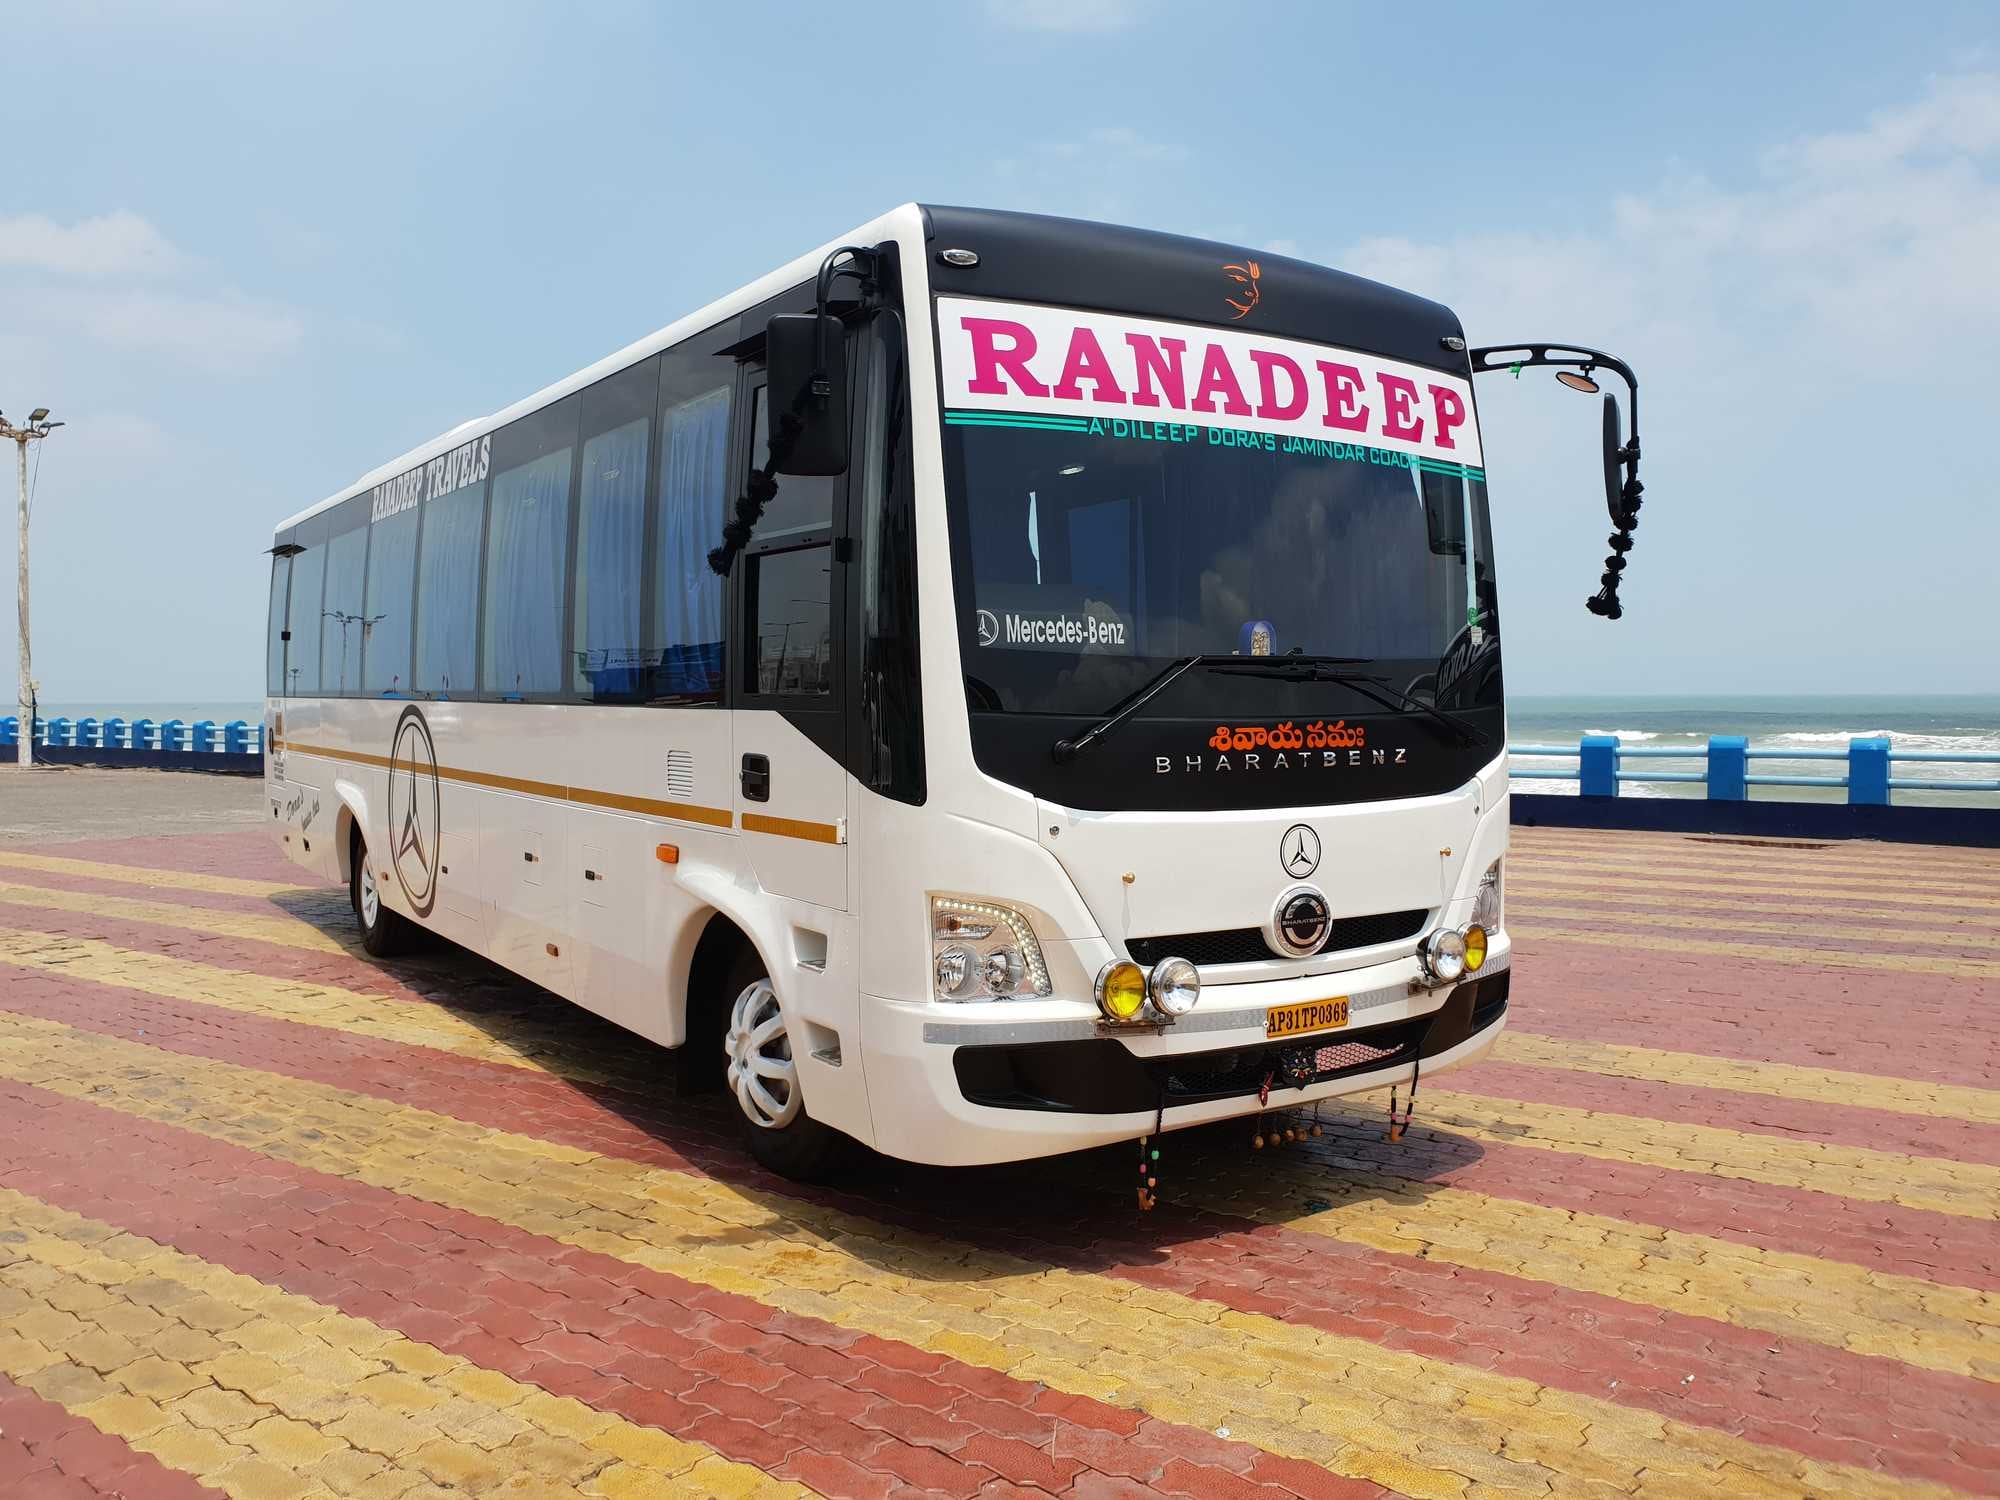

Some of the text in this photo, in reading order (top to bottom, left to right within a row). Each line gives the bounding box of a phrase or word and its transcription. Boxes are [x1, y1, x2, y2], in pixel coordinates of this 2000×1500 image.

[960, 316, 1466, 450] RANADEEP
[1208, 427, 1276, 451] DORA'S
[1282, 438, 1366, 463] JAMINDAR
[371, 434, 491, 524] RANADEEP TRAVELS
[1005, 614, 1125, 645] Mercedes-Benz
[1156, 748, 1407, 774] BHARATBENZ
[1267, 1002, 1348, 1034] AP31TP0369
